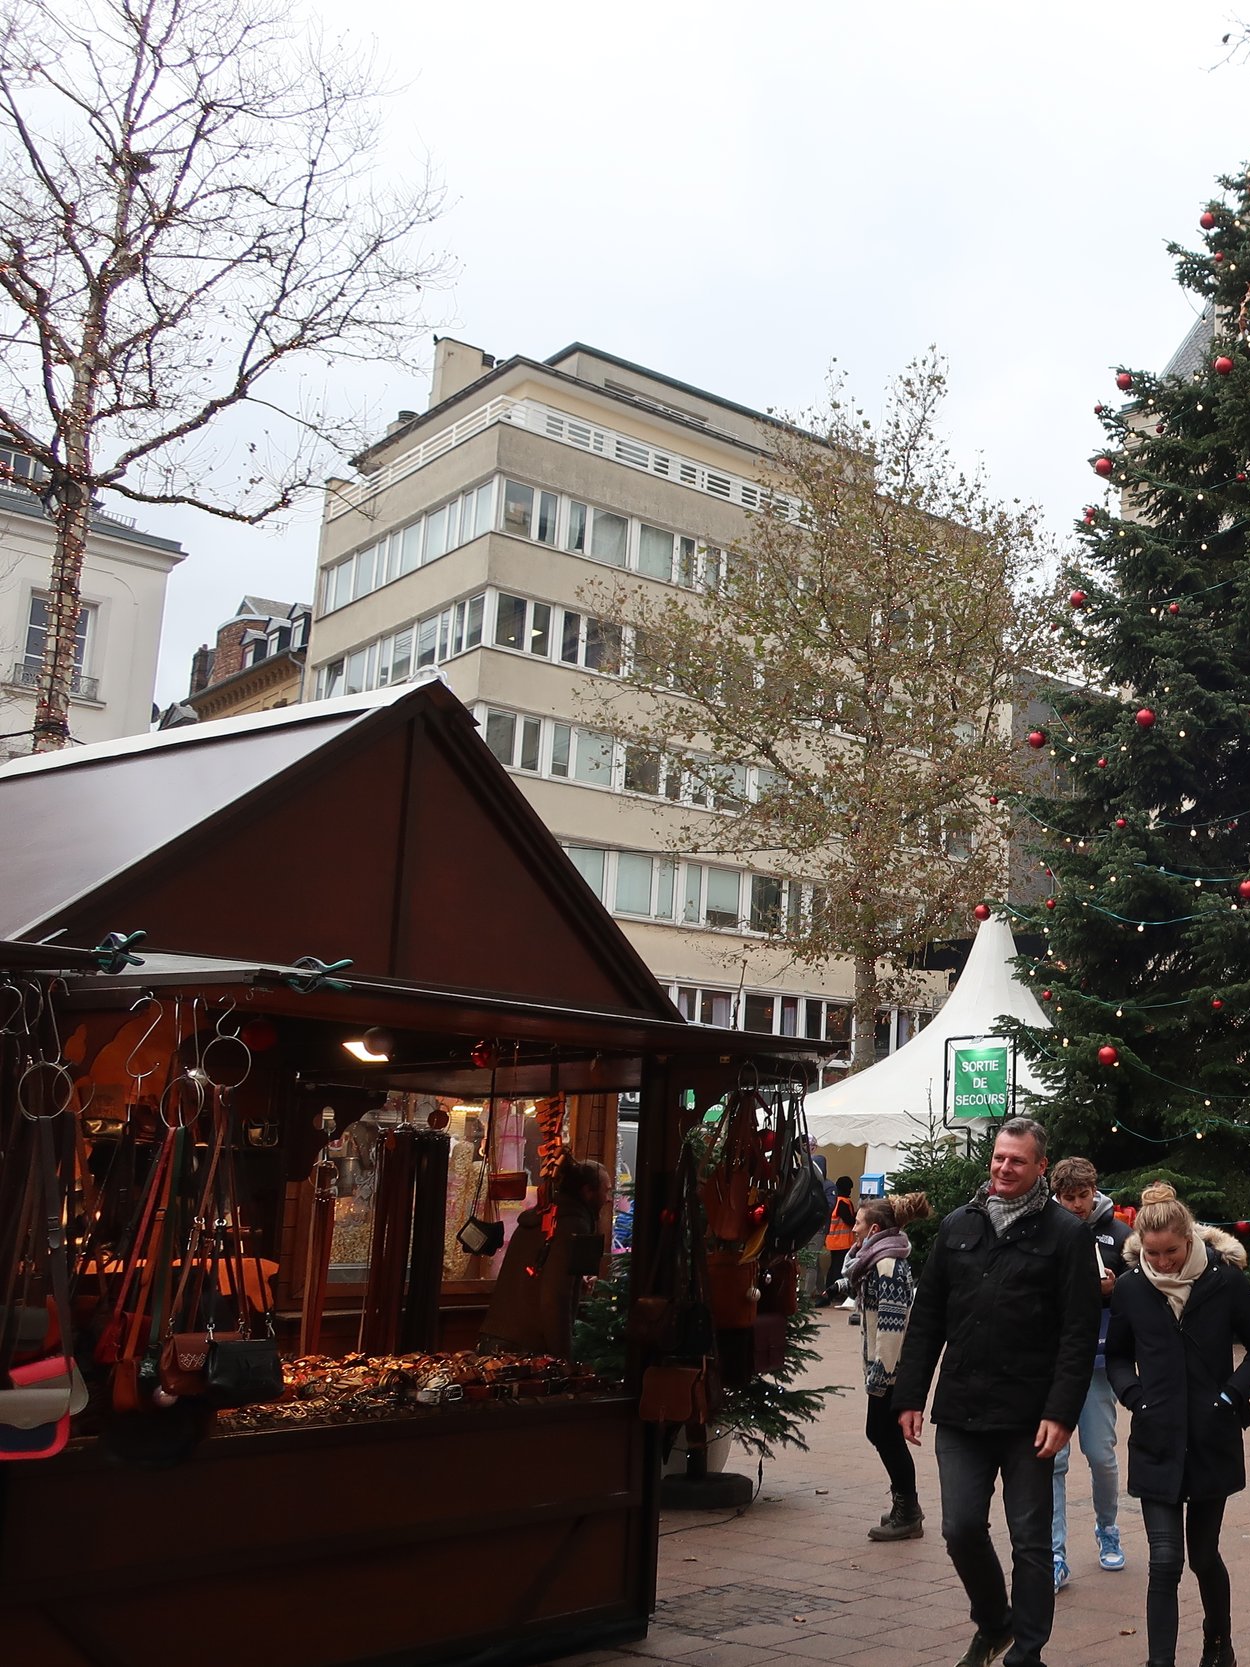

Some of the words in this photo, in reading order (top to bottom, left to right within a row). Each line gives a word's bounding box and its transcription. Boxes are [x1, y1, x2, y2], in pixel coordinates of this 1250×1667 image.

[962, 1060, 999, 1072] SORTIE
[973, 1078, 987, 1088] DE
[956, 1094, 1005, 1105] SECOURS
